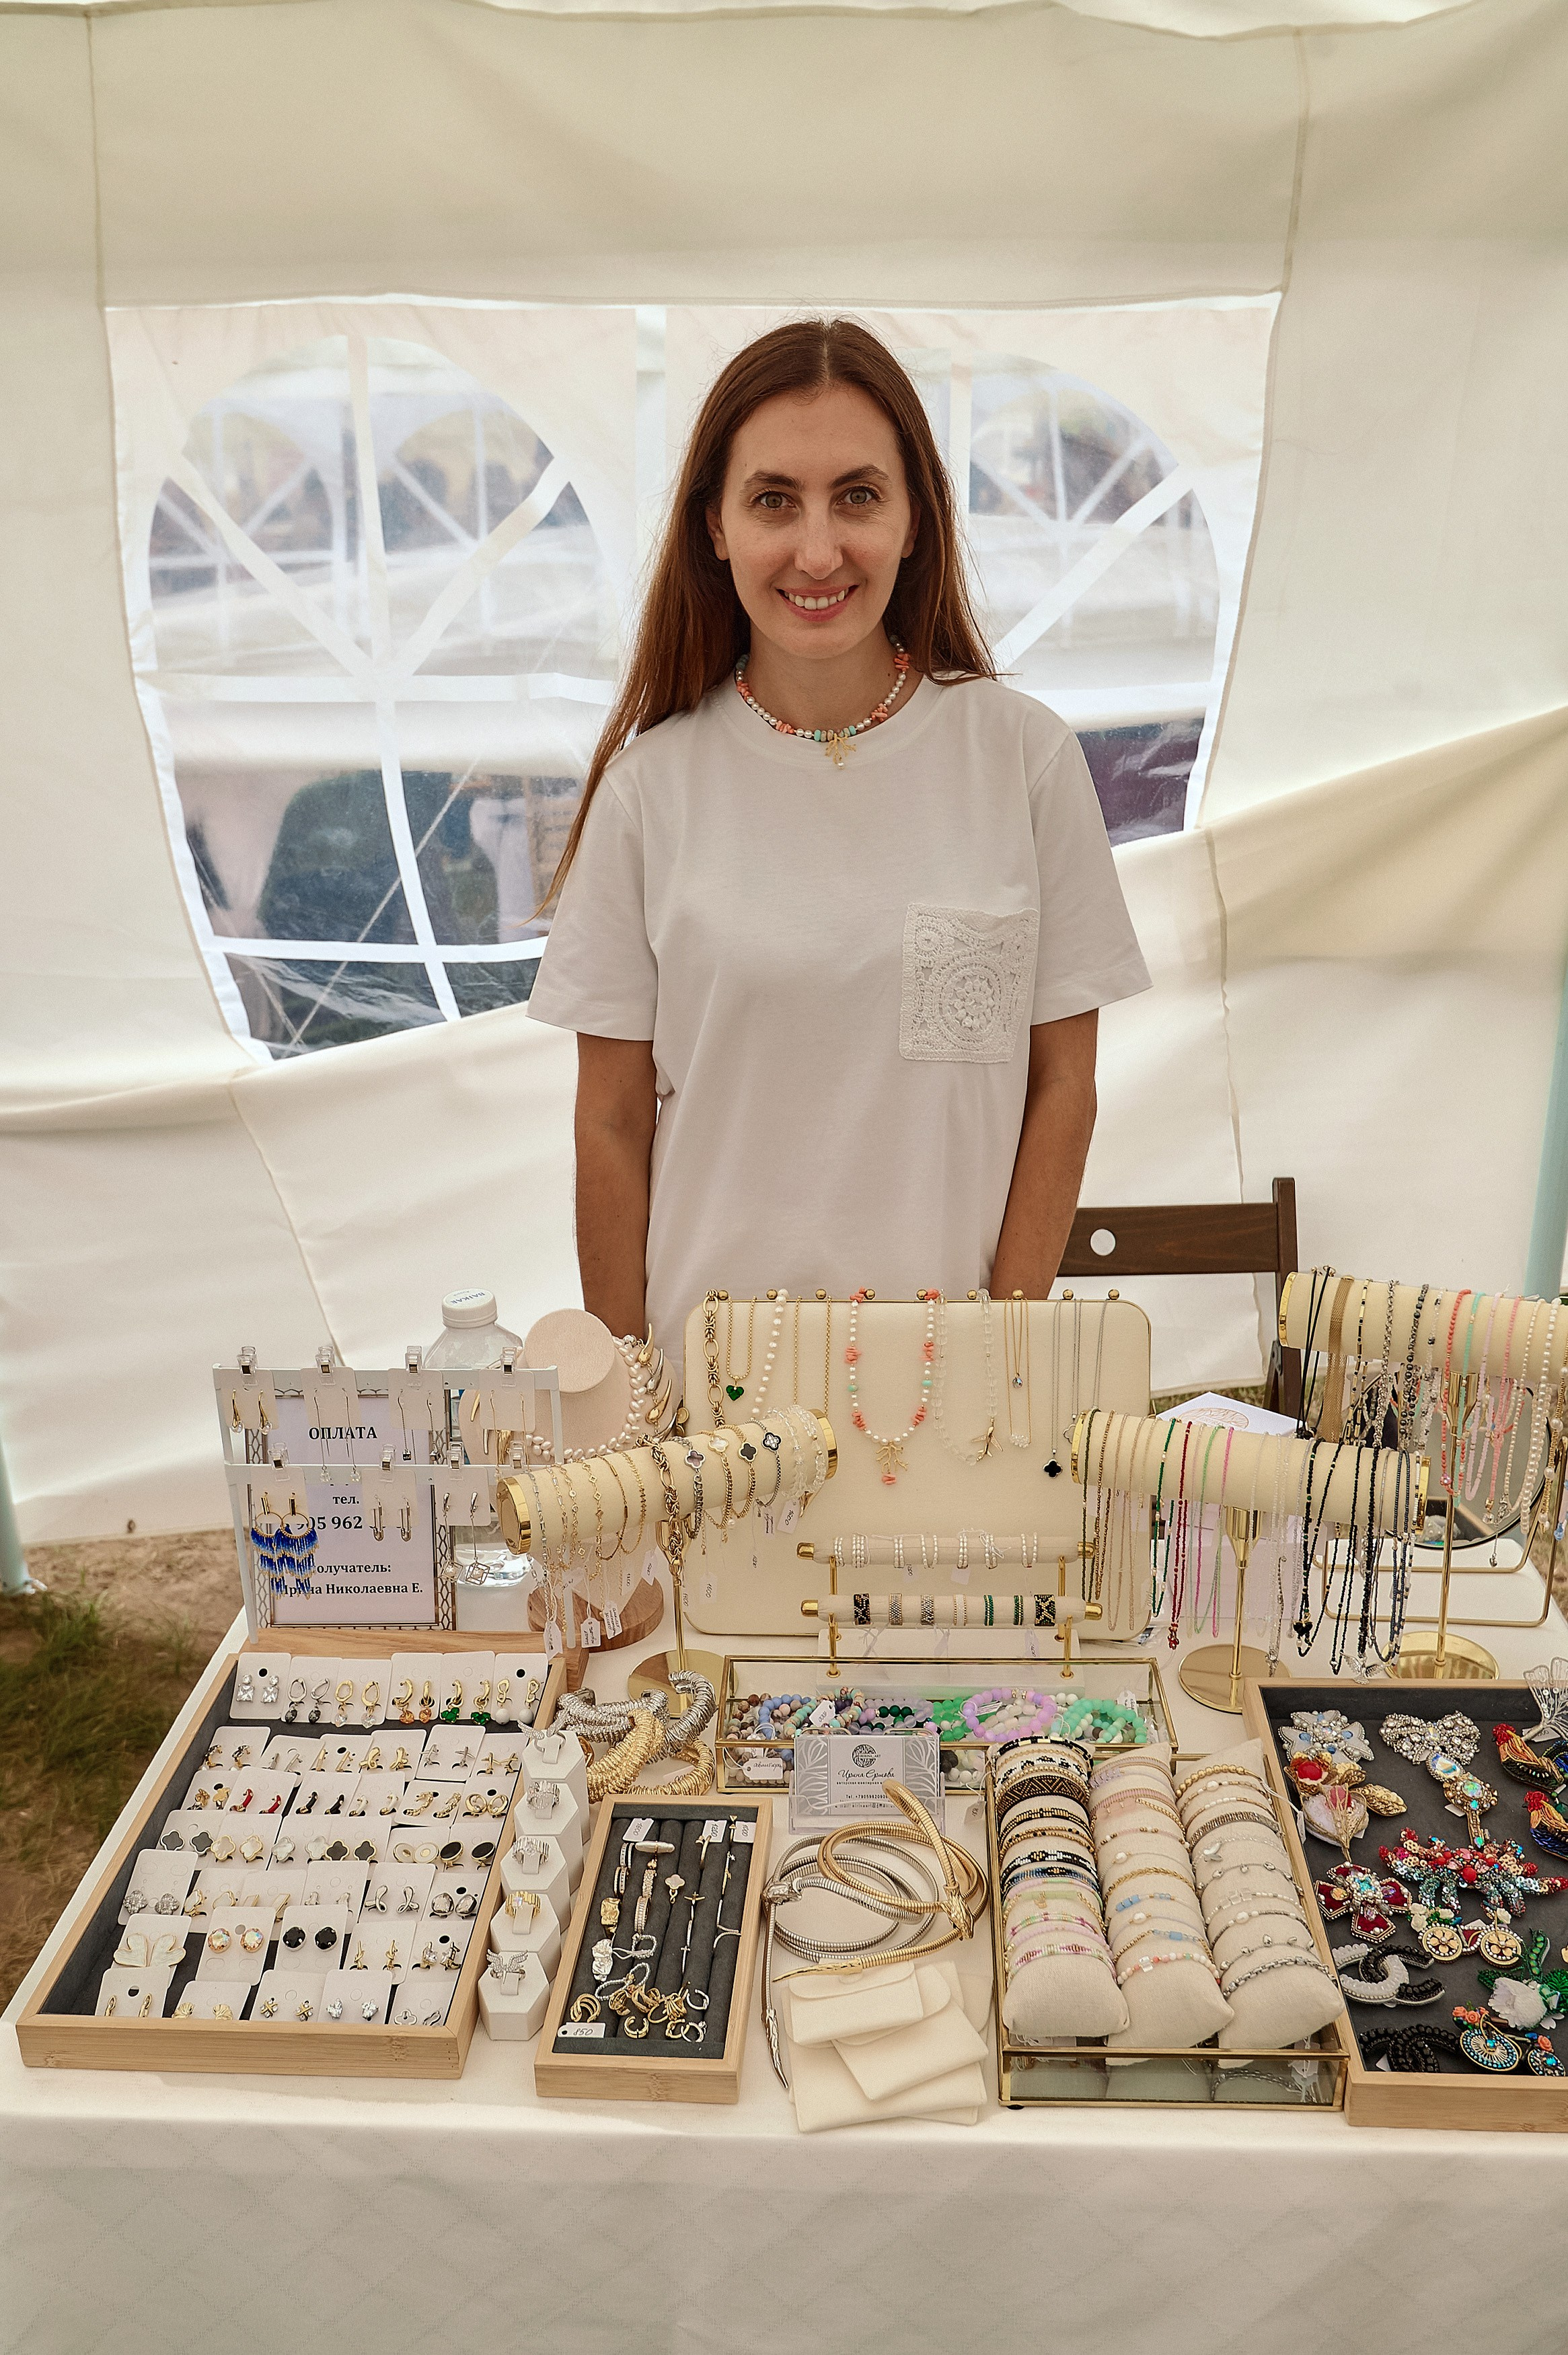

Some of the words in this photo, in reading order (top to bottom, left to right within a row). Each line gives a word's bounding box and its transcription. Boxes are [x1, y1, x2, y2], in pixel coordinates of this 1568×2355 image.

[309, 1426, 377, 1439] ОПЛАТА
[332, 1496, 360, 1505] тел.
[331, 1516, 363, 1529] 962
[784, 1510, 794, 1525] 1600
[314, 1564, 391, 1575] олучатель:
[326, 1583, 409, 1594] Николаевна
[412, 1583, 423, 1593] Е.
[818, 1710, 827, 1723] 1000
[837, 1769, 864, 1781] Ирина
[866, 1767, 895, 1781] Ершова
[633, 1822, 643, 1836] 1600
[710, 1823, 720, 1838] 1200
[741, 1824, 749, 1838] 1000
[573, 2027, 593, 2036] 850
